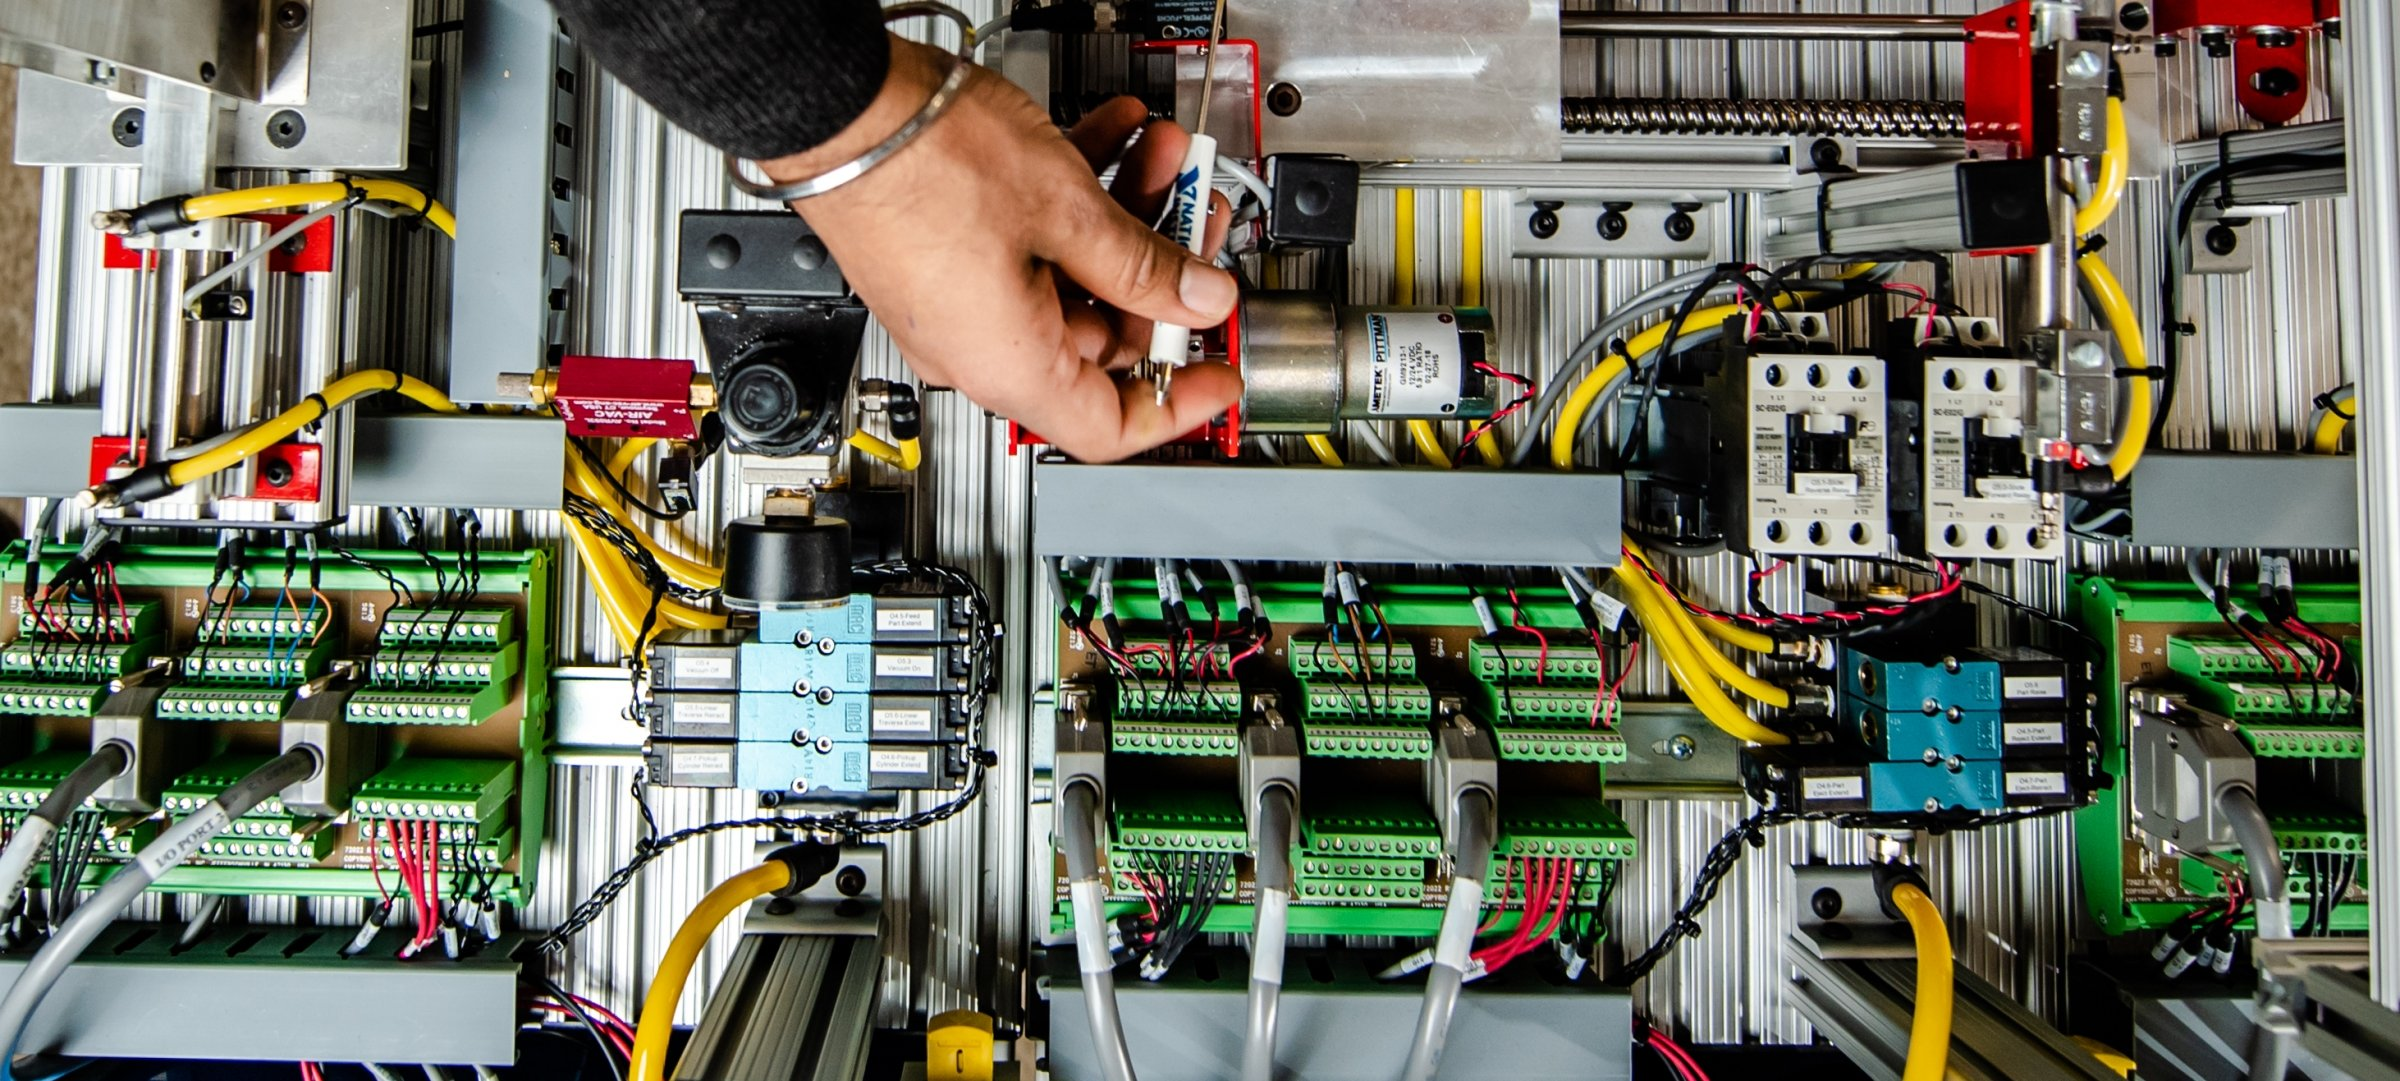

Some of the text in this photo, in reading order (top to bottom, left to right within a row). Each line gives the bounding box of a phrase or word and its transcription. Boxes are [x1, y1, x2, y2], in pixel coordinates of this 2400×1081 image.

[1371, 312, 1386, 362] PITTMAN
[594, 410, 653, 418] AIR-VAC
[155, 848, 177, 867] I/O
[177, 819, 214, 851] PORT
